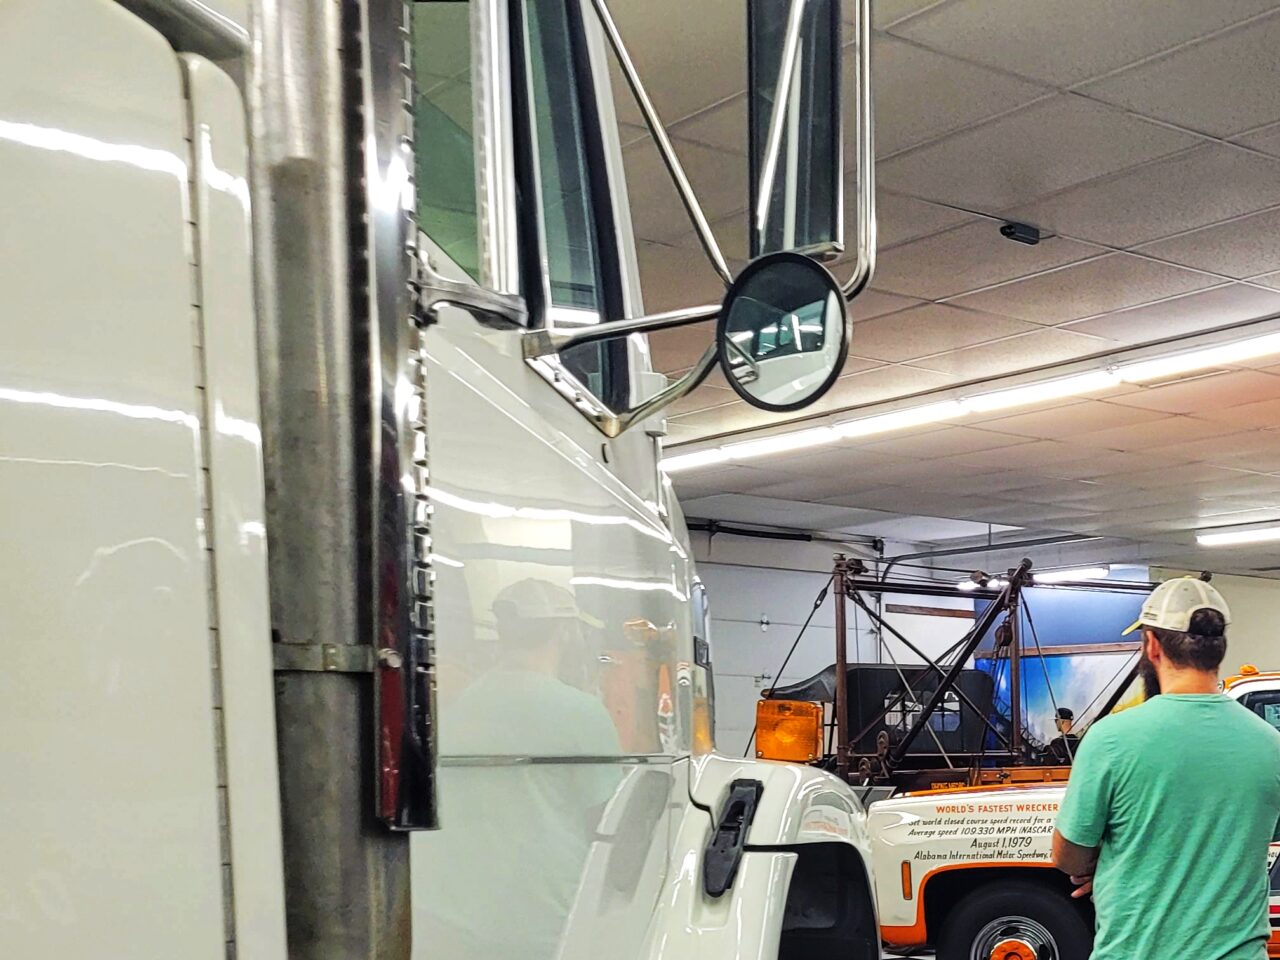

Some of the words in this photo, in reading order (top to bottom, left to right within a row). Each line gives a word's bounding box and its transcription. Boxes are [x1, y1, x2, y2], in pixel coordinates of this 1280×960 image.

[936, 804, 974, 813] WORLD'S
[978, 804, 1013, 813] FASTEST
[1016, 803, 1059, 812] WRECKER
[922, 817, 942, 825] world
[944, 817, 964, 825] closed
[990, 816, 1007, 825] speed
[1009, 816, 1031, 824] record
[1033, 816, 1044, 826] for
[908, 829, 936, 838] Average
[937, 828, 958, 839] speed
[996, 826, 1017, 834] MPH
[970, 838, 1000, 850] August
[914, 851, 947, 860] Alabama
[949, 850, 995, 860] International
[996, 850, 1016, 859] Motor
